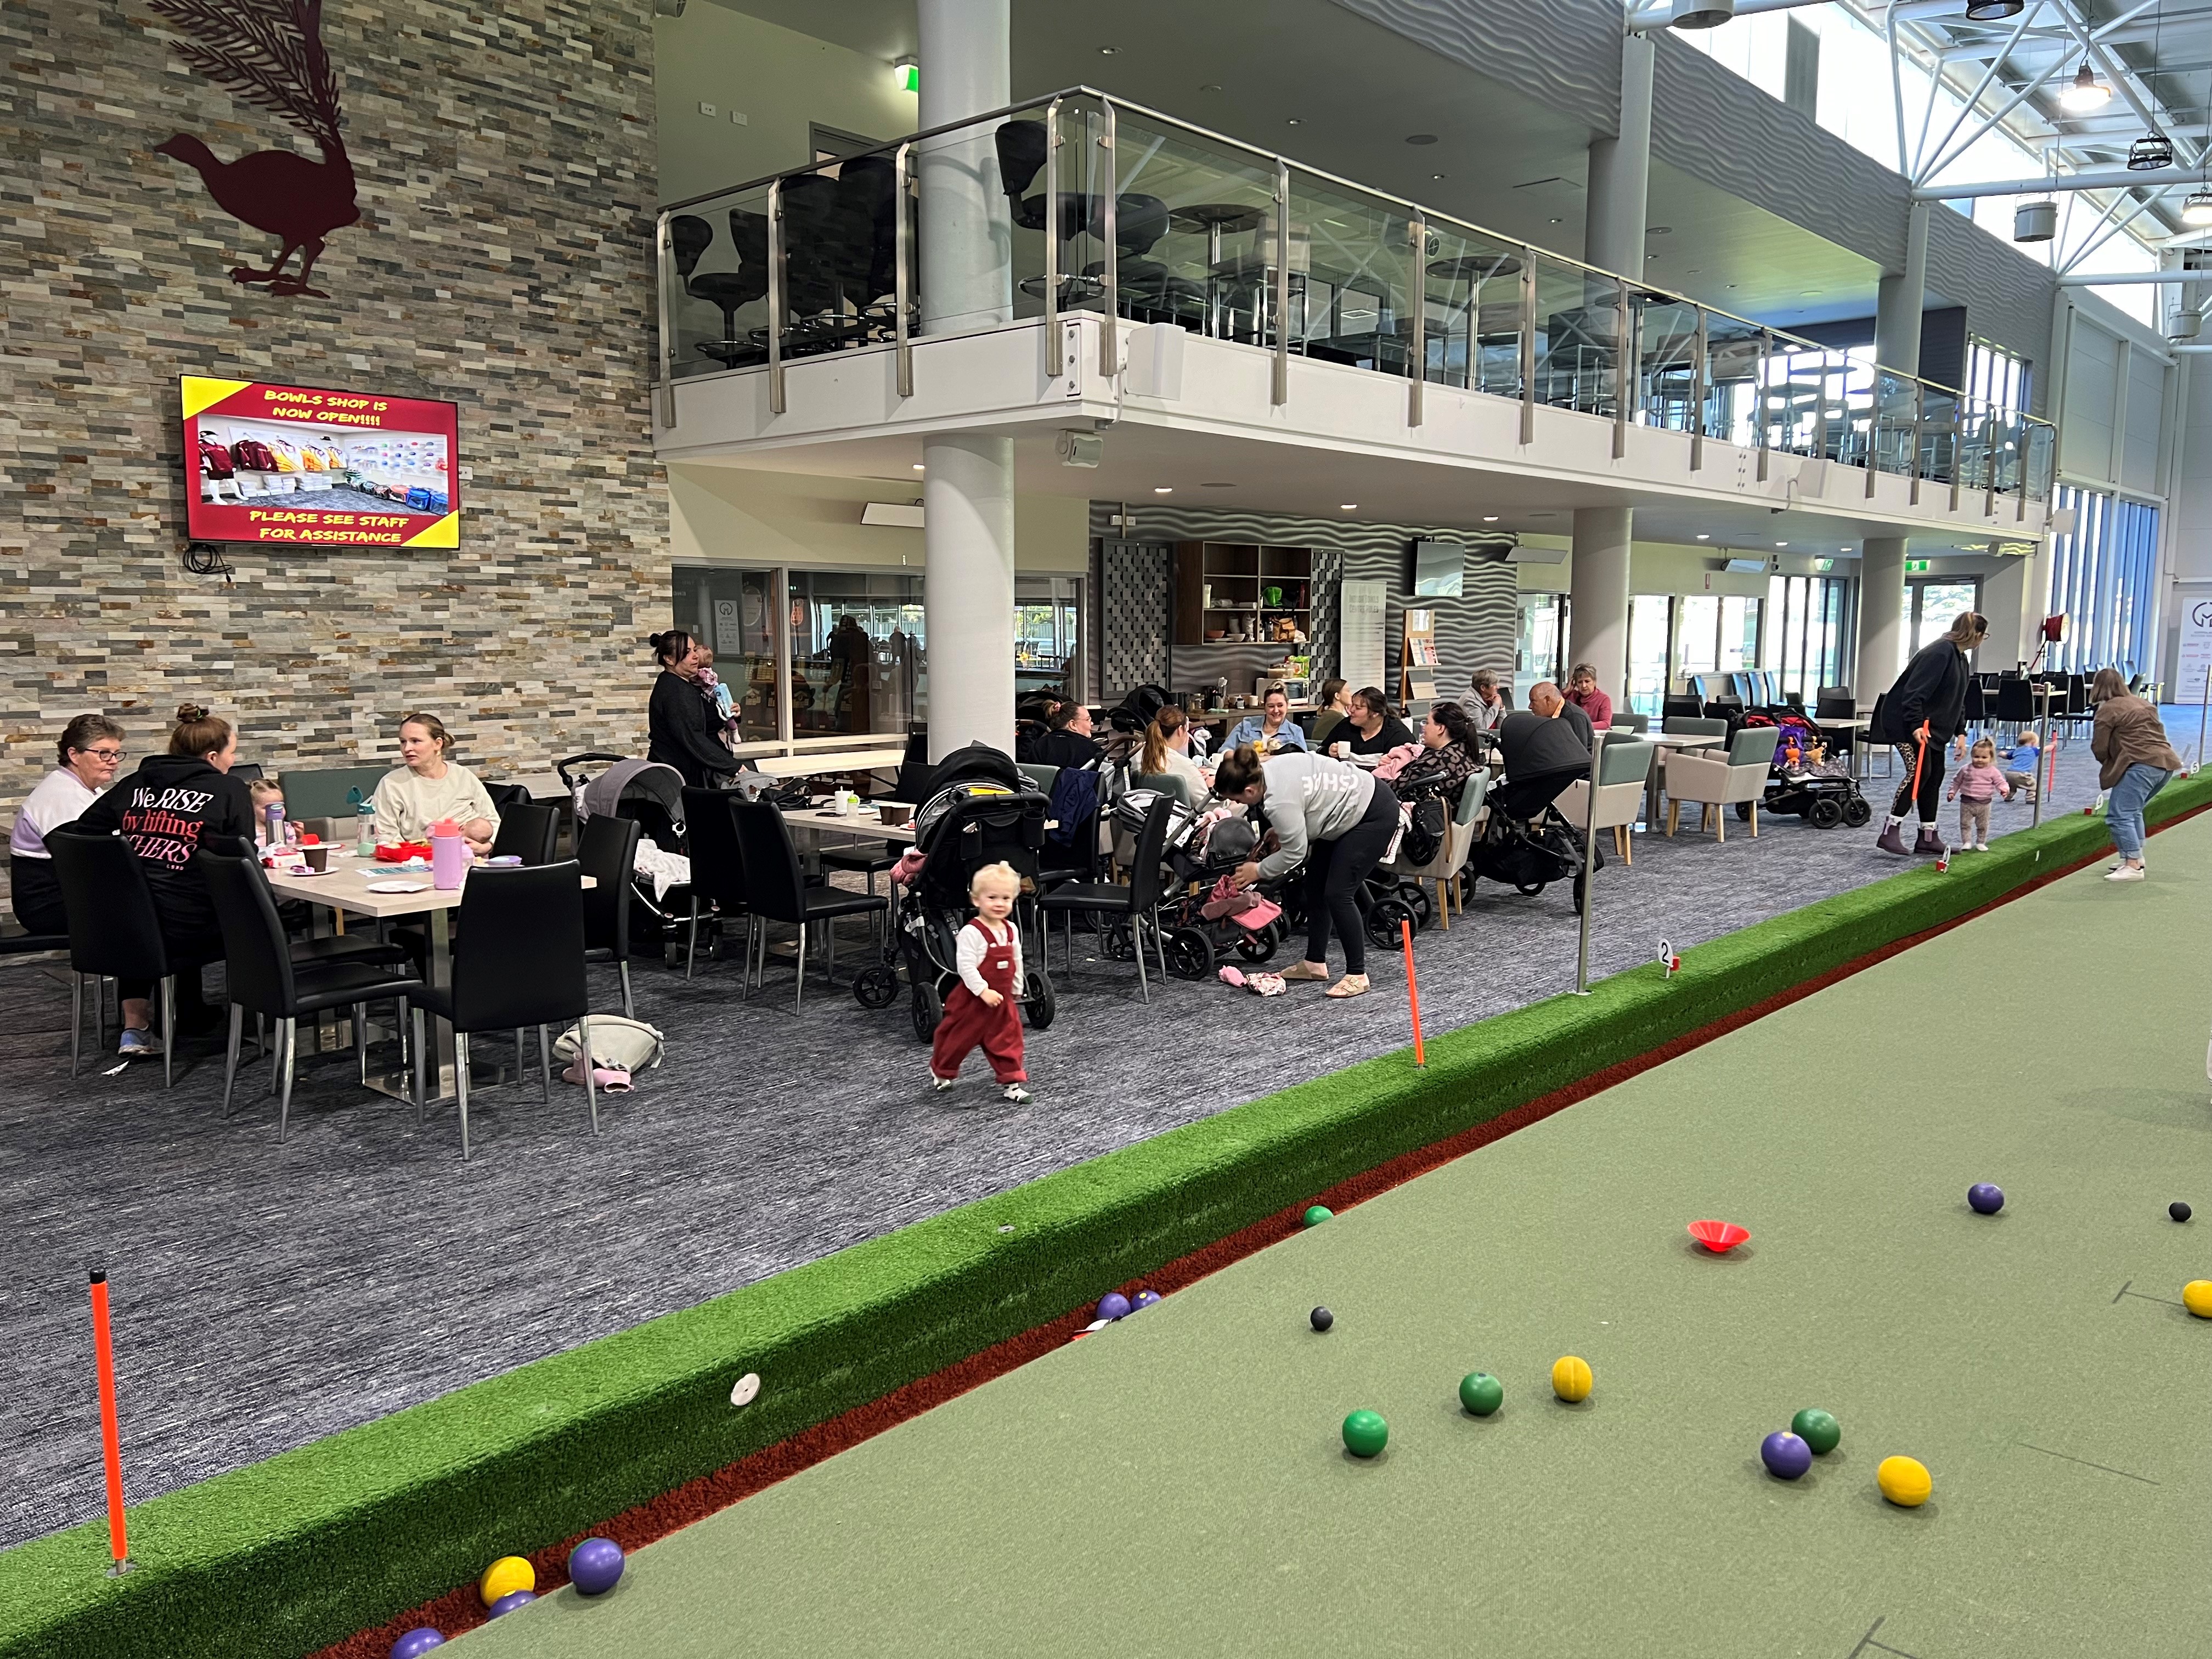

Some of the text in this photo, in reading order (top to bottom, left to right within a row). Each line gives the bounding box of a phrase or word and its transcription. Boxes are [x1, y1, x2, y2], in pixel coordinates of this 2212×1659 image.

[264, 390, 388, 411] BOWLS SHOP IS
[273, 407, 380, 426] NOW OPEN!!!!
[250, 510, 409, 528] PLEASE SEE STAFF
[259, 528, 402, 543] FOR ASSISTANCE
[2193, 762, 2198, 772] 5
[131, 787, 214, 813] We RISE
[122, 809, 204, 843] by lifting
[127, 834, 198, 863] THERS
[1661, 942, 1669, 964] 2
